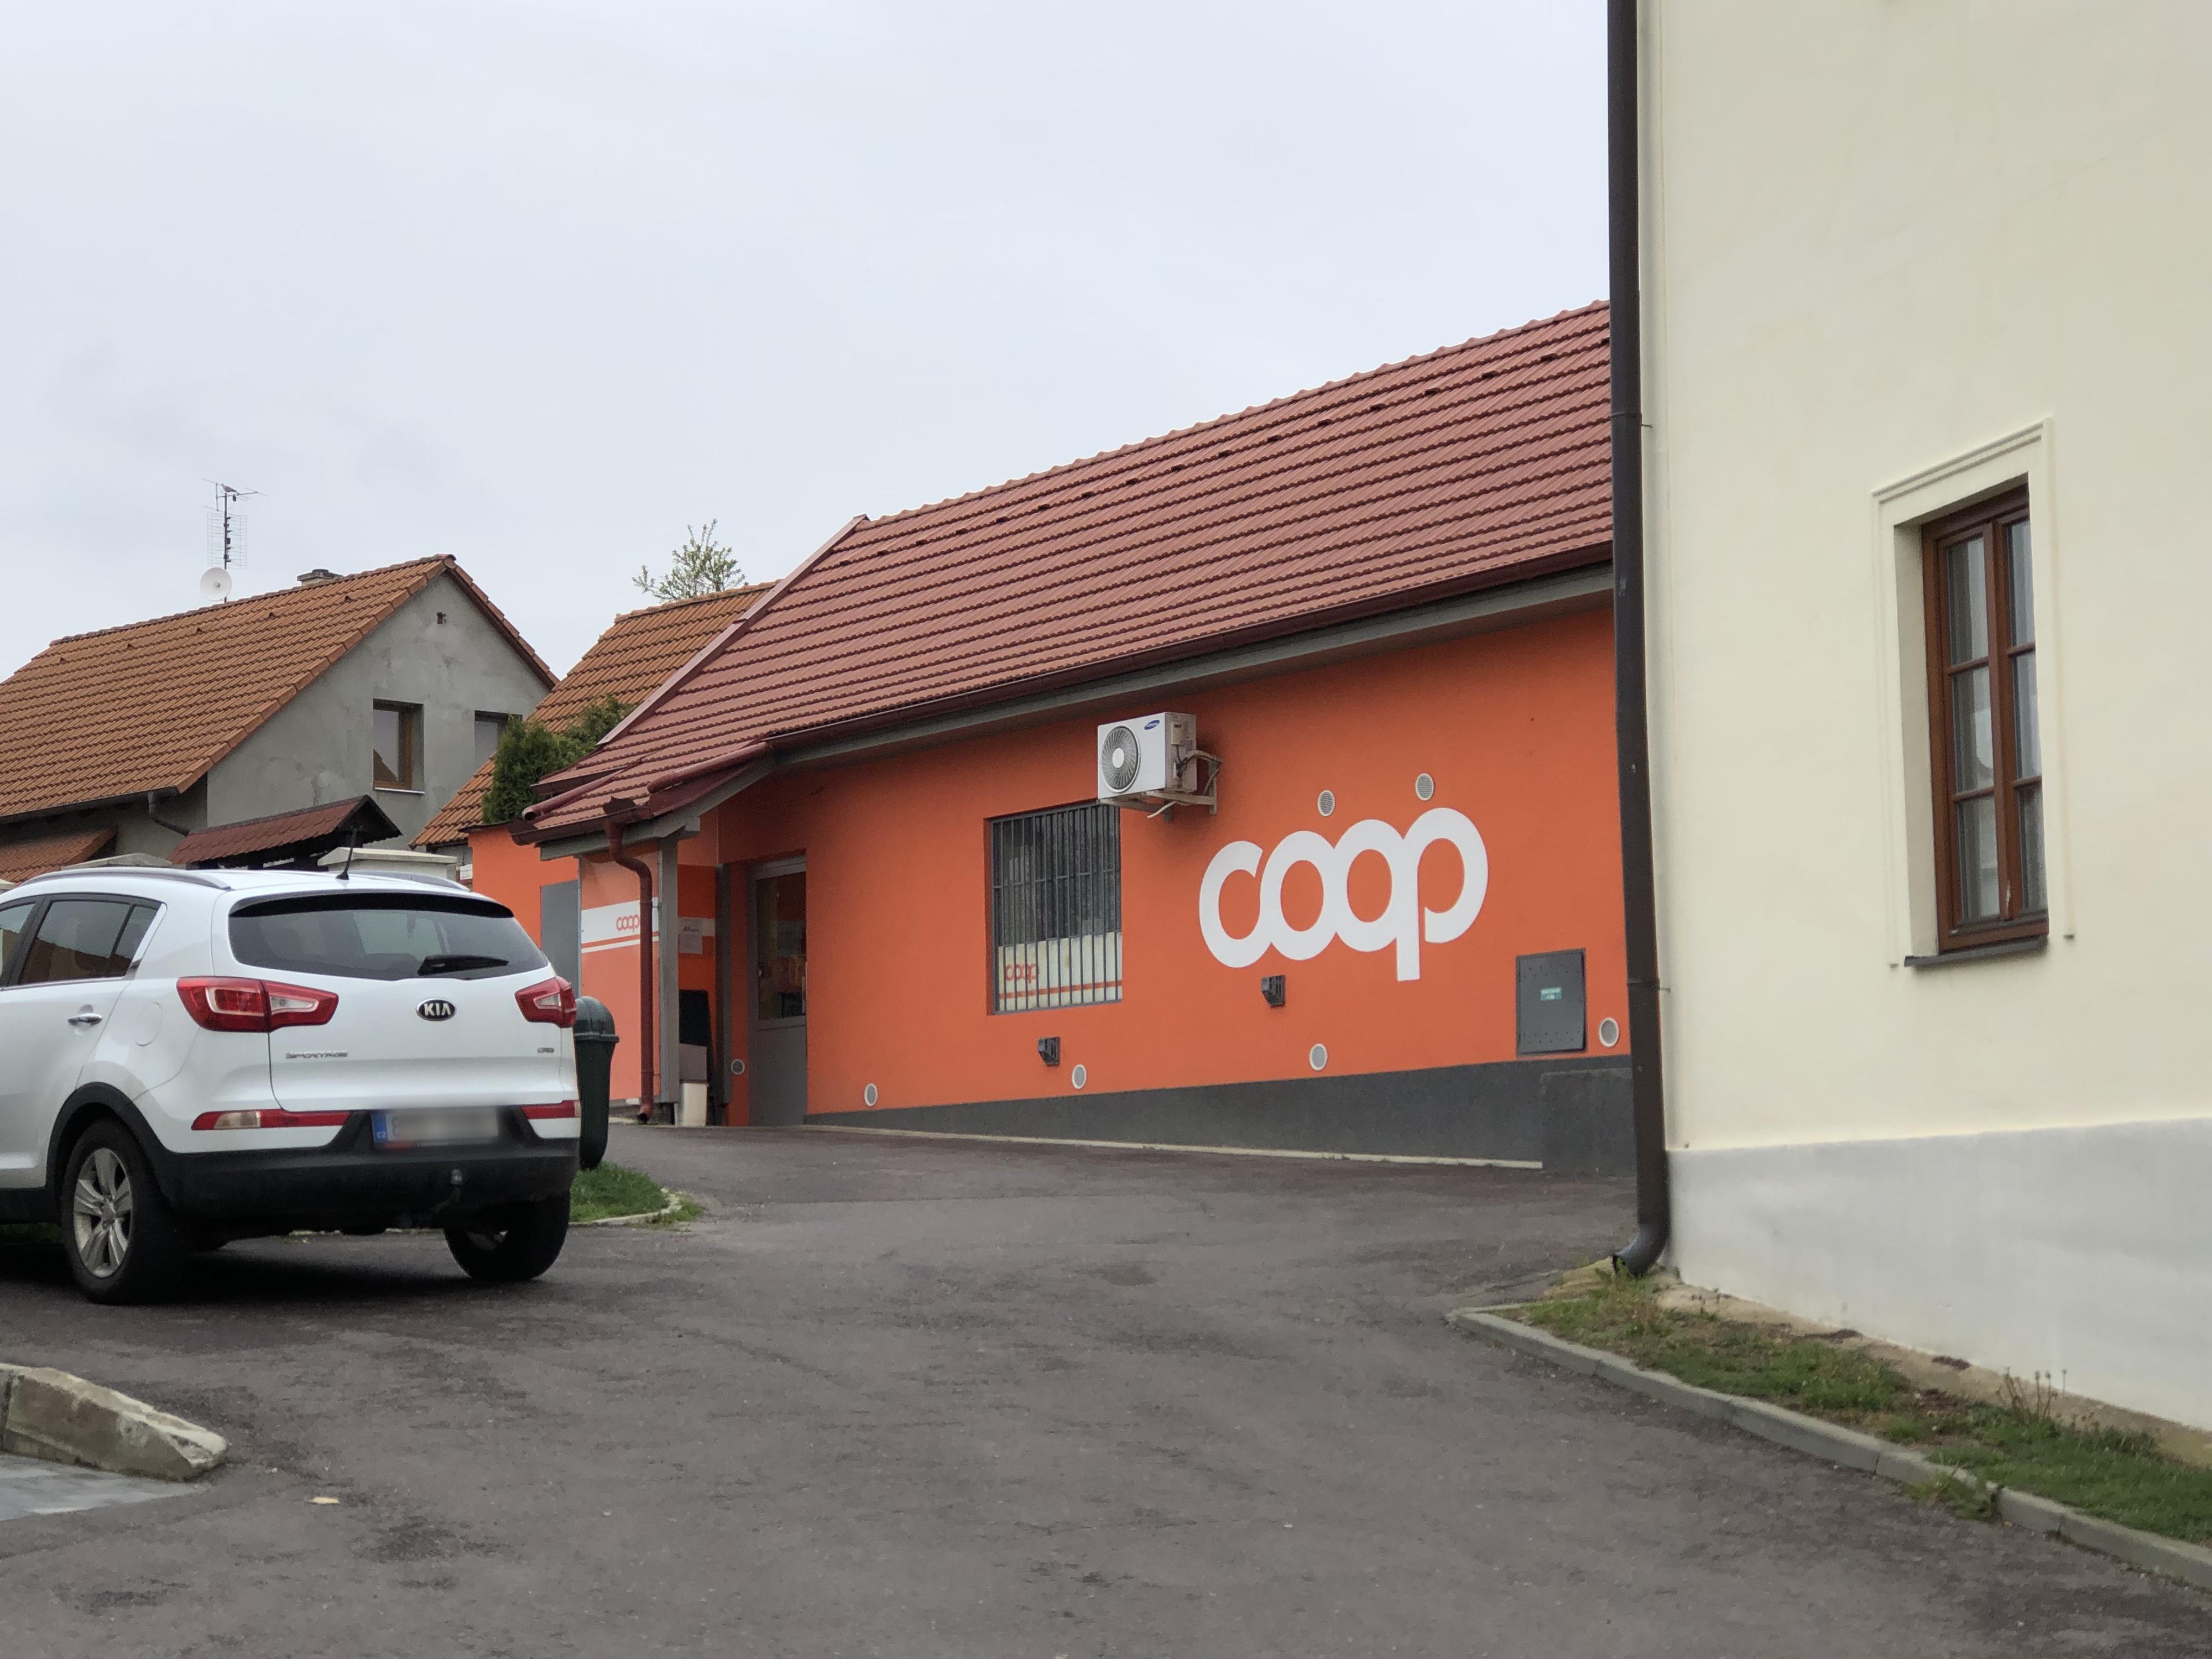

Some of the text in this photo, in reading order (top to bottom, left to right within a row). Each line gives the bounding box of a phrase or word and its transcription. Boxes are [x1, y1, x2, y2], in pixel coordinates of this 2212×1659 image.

[1199, 807, 1488, 981] coop
[616, 914, 640, 933] coop
[424, 1003, 451, 1016] KIA
